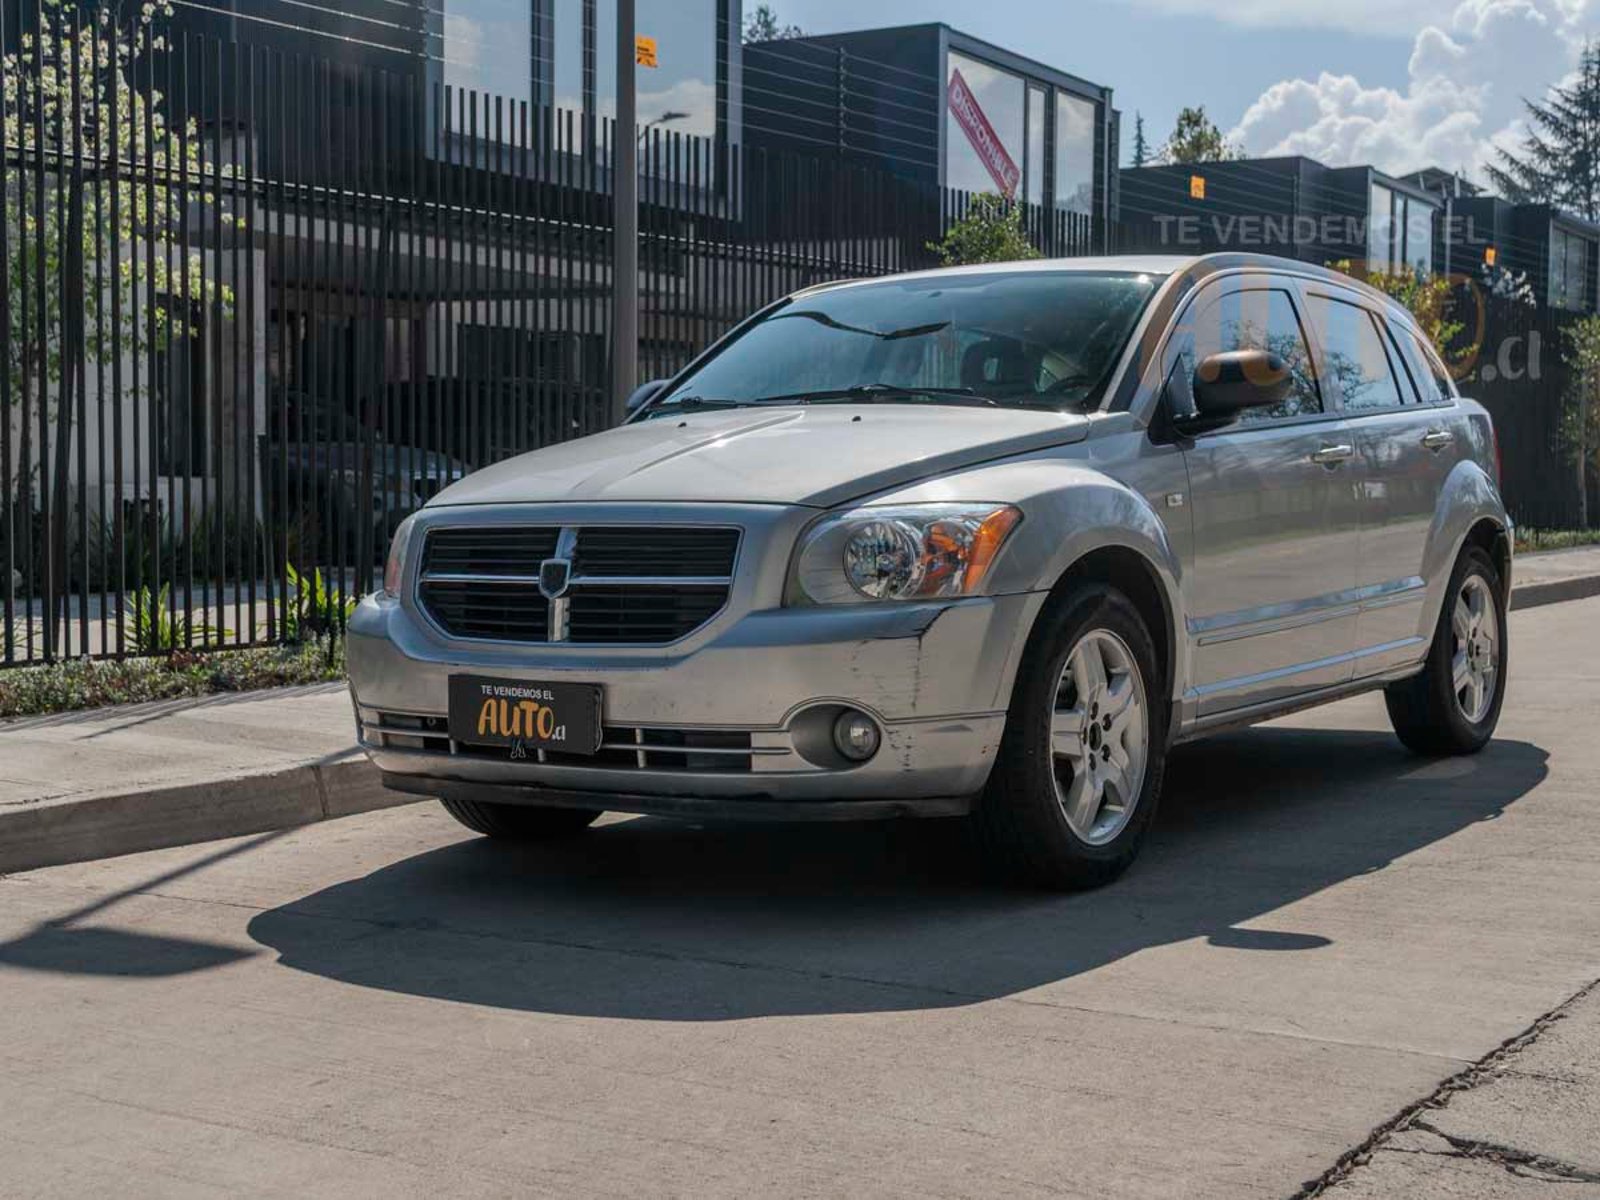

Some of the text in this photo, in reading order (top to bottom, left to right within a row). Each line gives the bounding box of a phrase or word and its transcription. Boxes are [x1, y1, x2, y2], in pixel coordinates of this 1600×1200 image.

[481, 685, 554, 700] TE VENDEMOS EL
